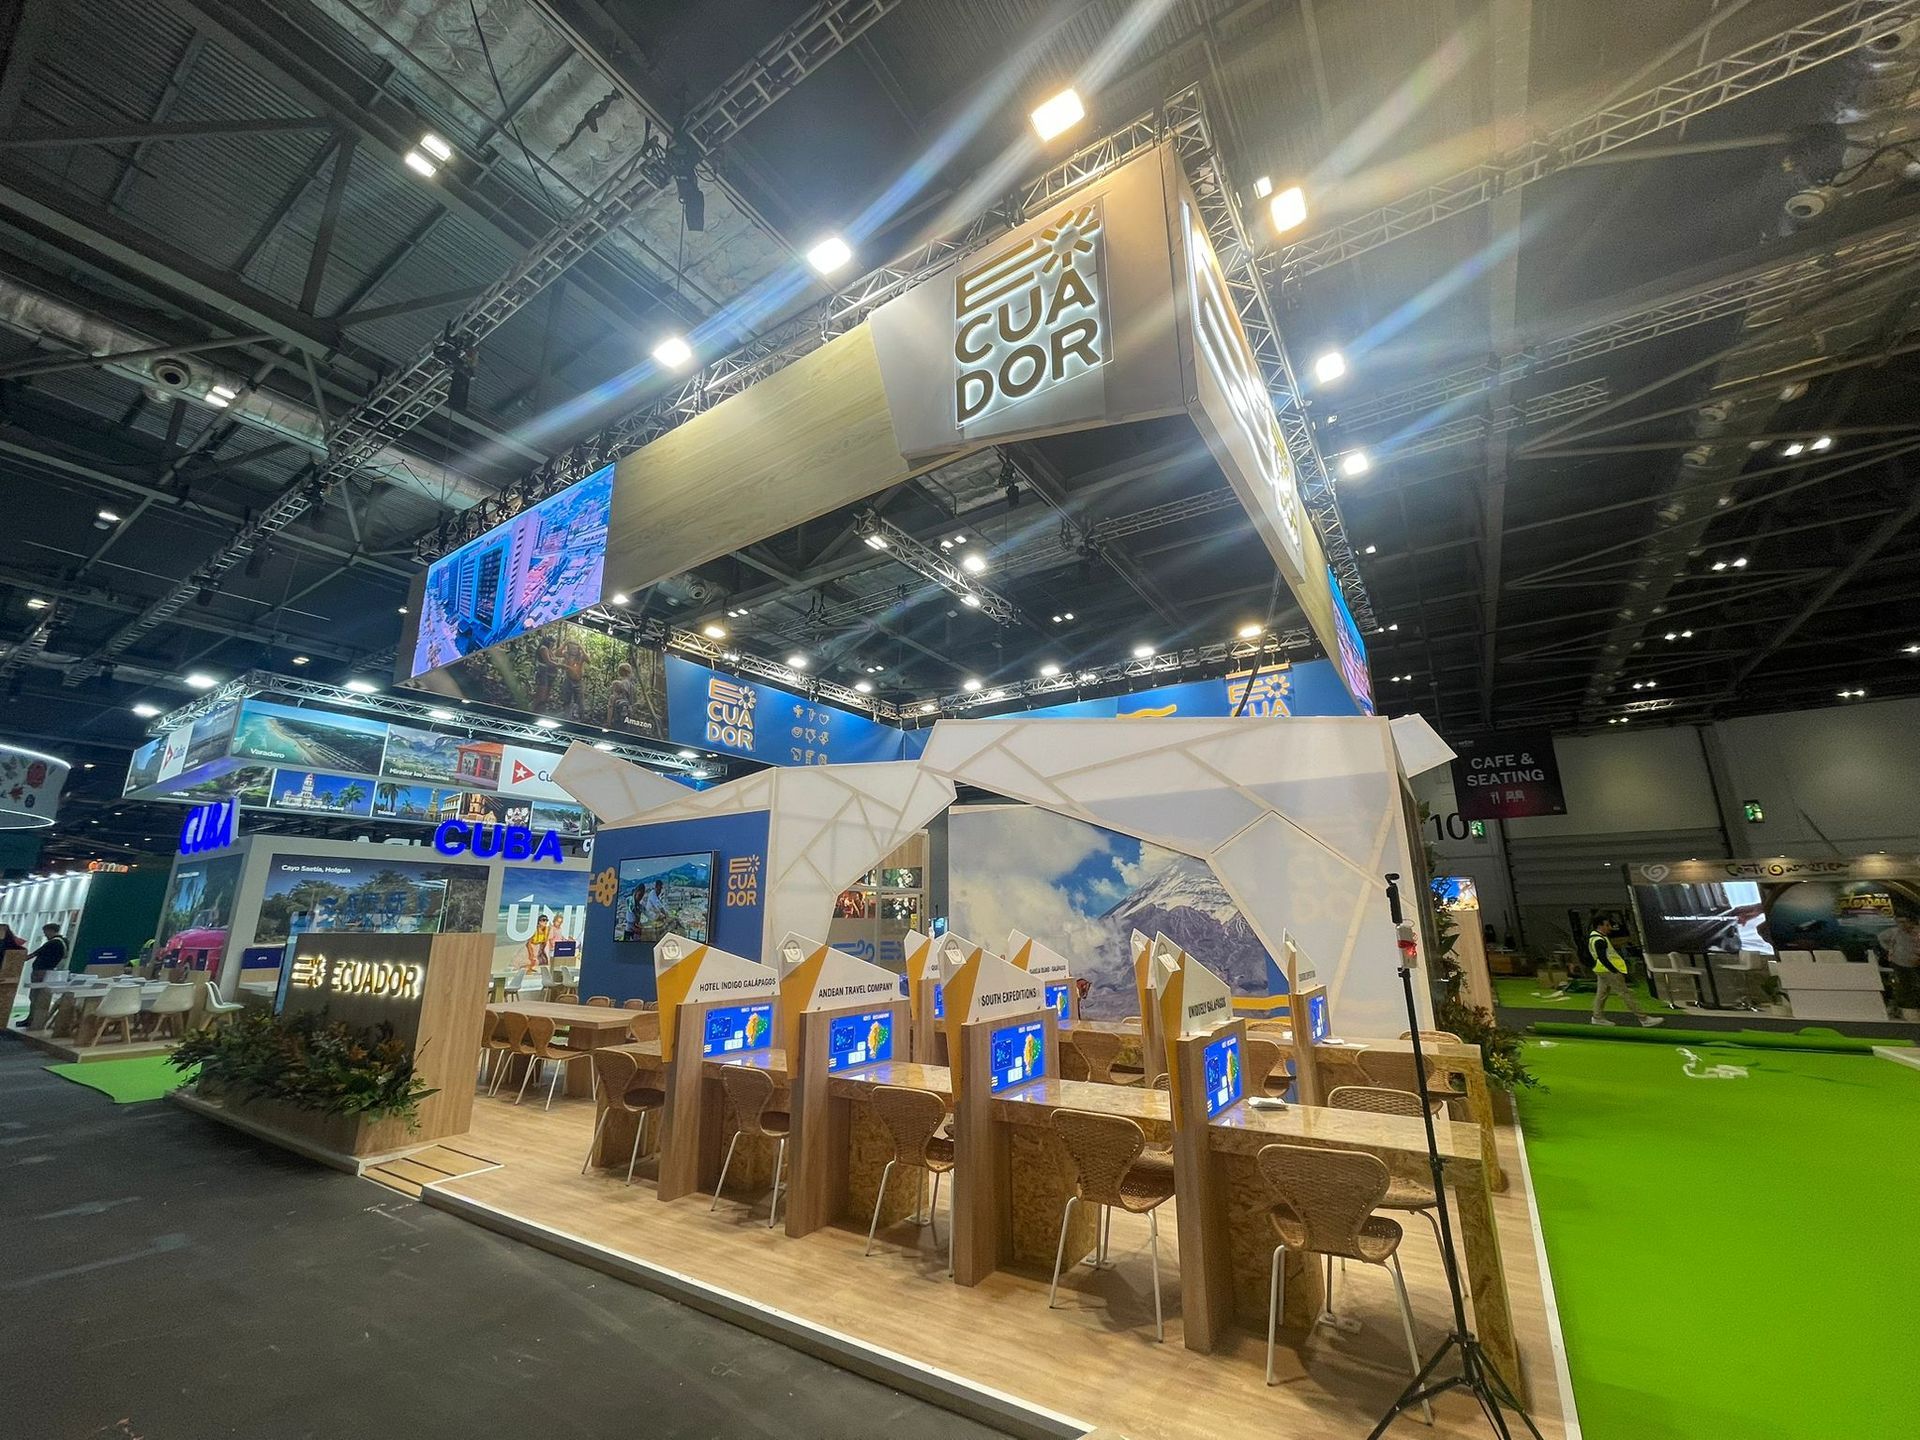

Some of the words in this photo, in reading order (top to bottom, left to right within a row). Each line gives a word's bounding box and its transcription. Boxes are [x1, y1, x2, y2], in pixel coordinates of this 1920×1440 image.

[955, 267, 1096, 364] CUA
[956, 318, 1102, 423] DOR
[623, 716, 652, 729] Amazon
[707, 701, 753, 729] CUA
[707, 721, 754, 751] DOR
[250, 747, 285, 759] Varadero
[1471, 754, 1517, 770] CAFE
[1521, 752, 1535, 765] &
[1466, 769, 1545, 787] SEATING
[1429, 812, 1470, 841] 10
[434, 818, 564, 864] CUBA
[728, 873, 757, 890] CUA
[727, 890, 757, 907] DOR
[331, 960, 424, 1000] ECUADOR
[700, 981, 719, 992] HOTEL
[722, 980, 742, 990] INDIGO
[818, 987, 844, 998] ANDEAN
[845, 984, 866, 995] TRAVEL
[867, 982, 894, 993] COMPANY
[981, 993, 1001, 1007] SOUTH
[1002, 988, 1037, 1003] EXPEDITIONS
